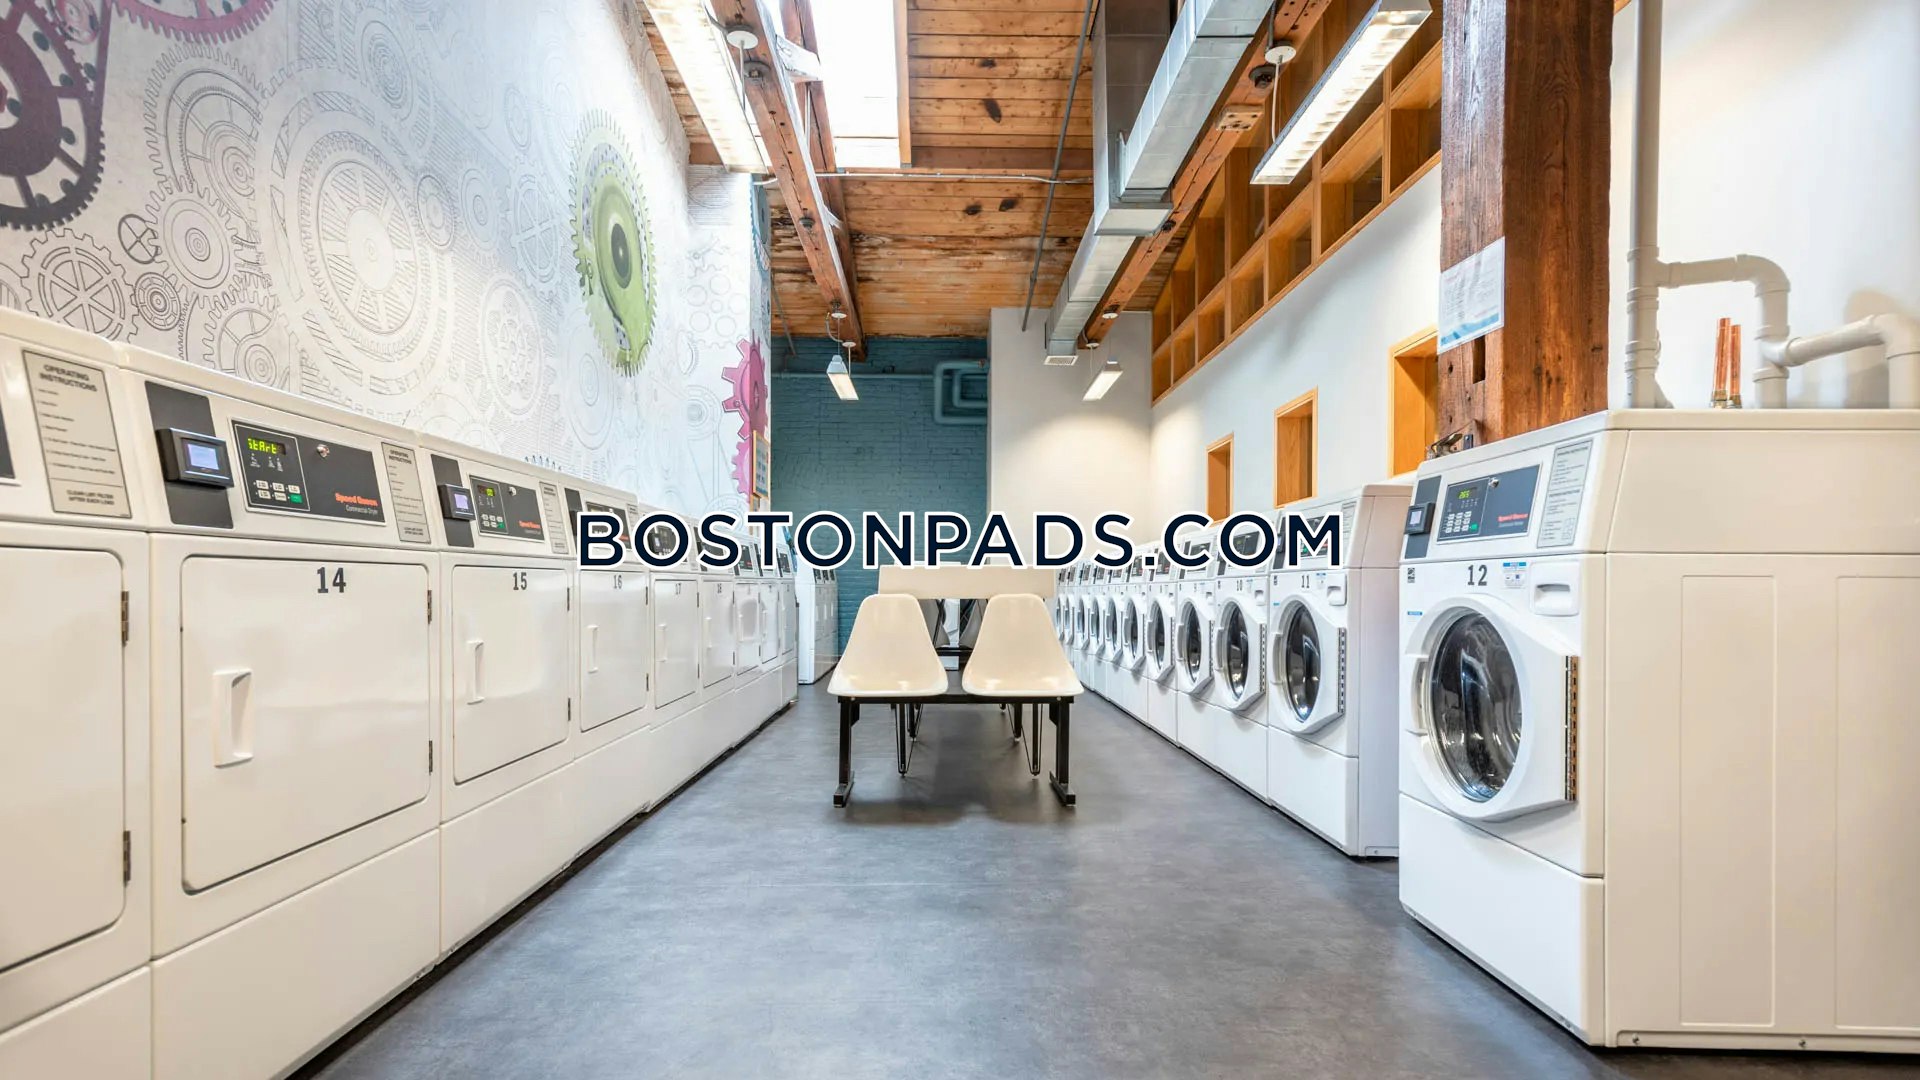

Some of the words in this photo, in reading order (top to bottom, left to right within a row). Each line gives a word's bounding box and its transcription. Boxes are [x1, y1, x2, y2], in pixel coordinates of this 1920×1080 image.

[43, 364, 90, 381] OPERATING
[39, 372, 98, 392] INSTRUCTIONS
[317, 566, 347, 594] 14
[513, 572, 528, 590] 15
[613, 575, 623, 590] 16
[1301, 574, 1310, 589] 11
[1467, 564, 1488, 586] 12
